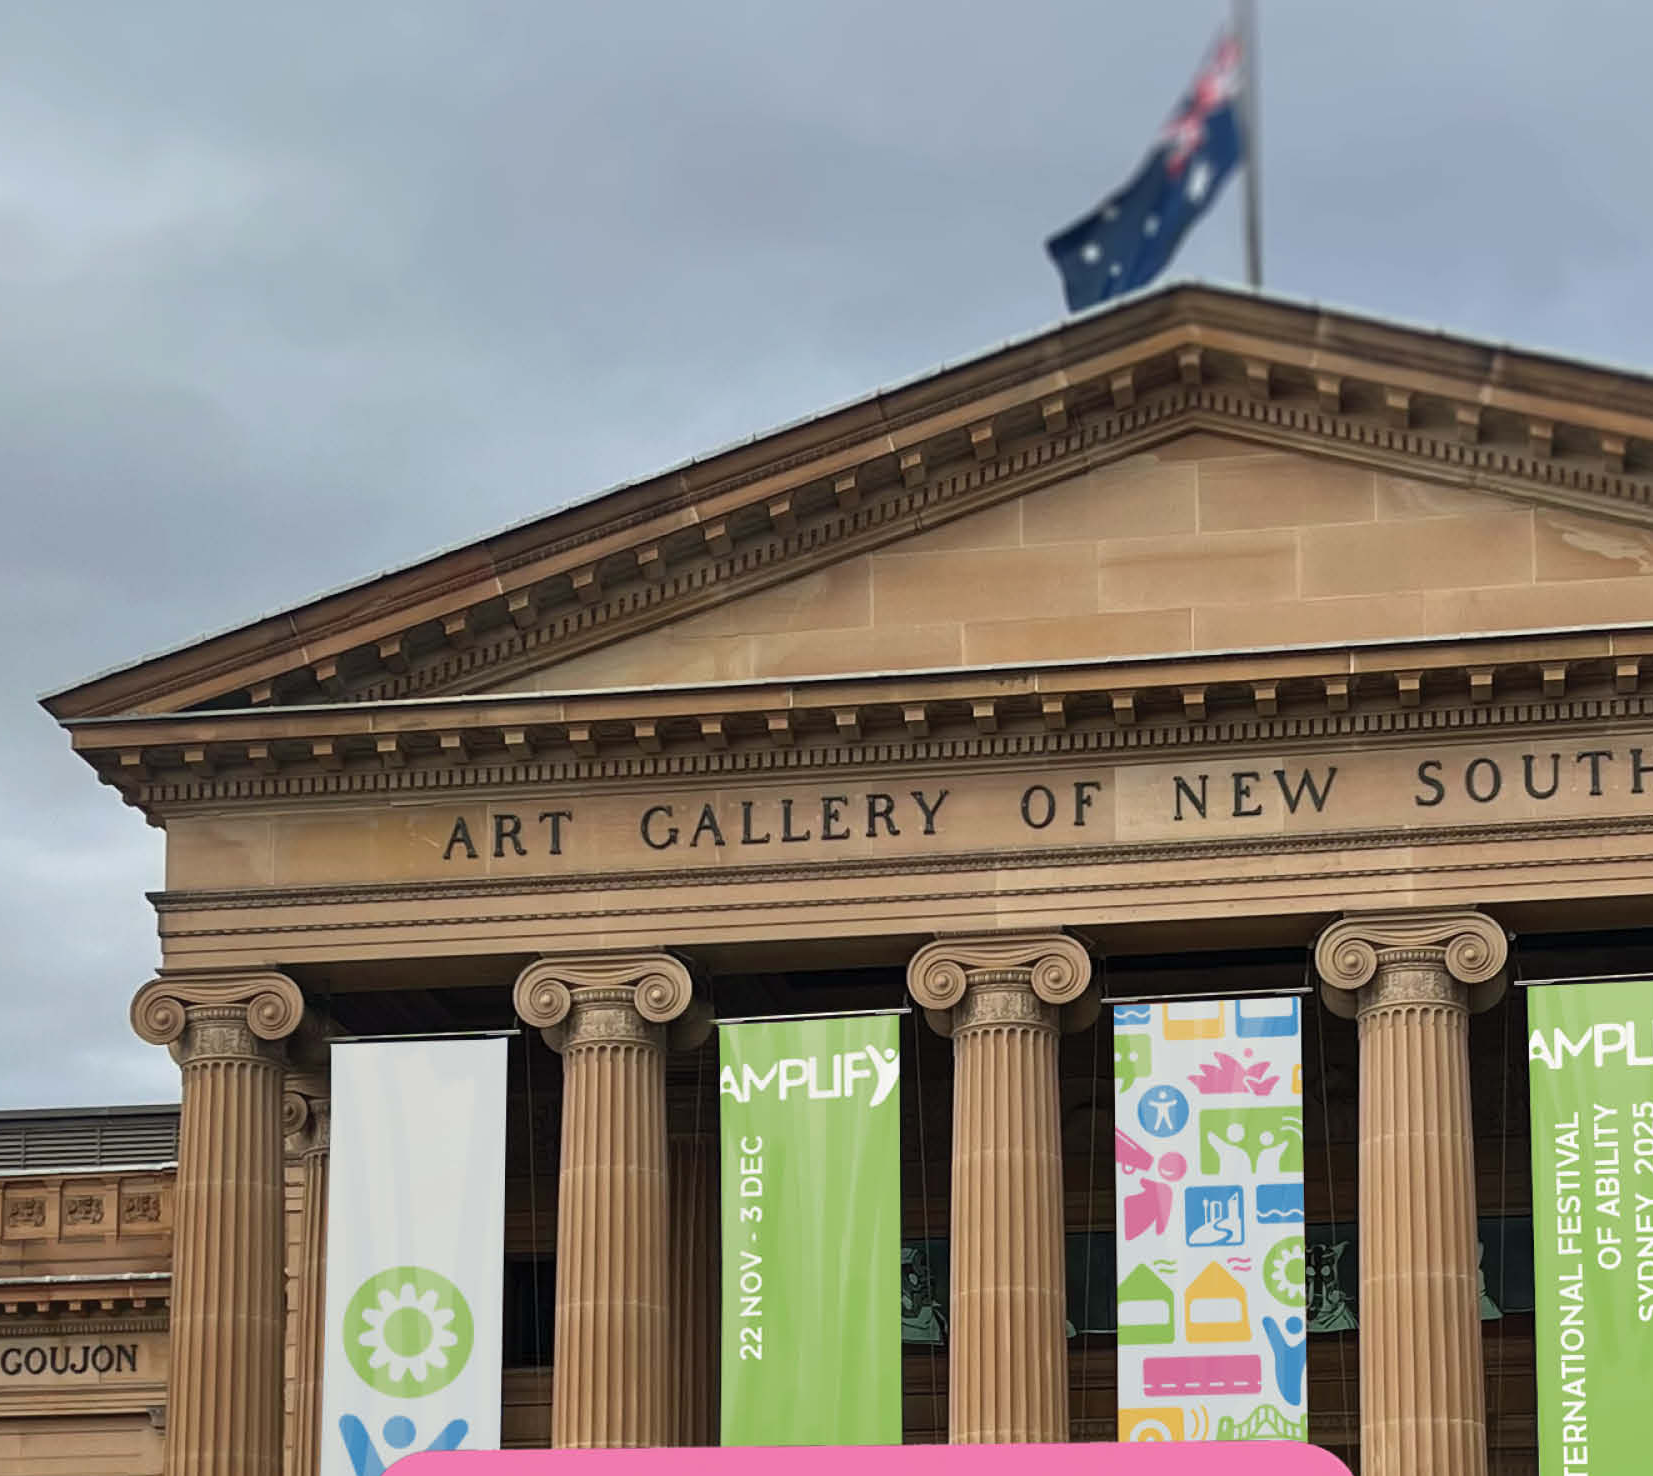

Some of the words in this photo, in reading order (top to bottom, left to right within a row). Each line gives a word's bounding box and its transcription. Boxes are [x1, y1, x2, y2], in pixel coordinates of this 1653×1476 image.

[442, 809, 574, 861] ART
[641, 788, 951, 849] GALLERY
[1020, 780, 1103, 830] OF
[1173, 765, 1338, 821] NEW
[720, 1045, 900, 1107] AMPLIFY
[739, 1135, 763, 1199] DEC
[1554, 1111, 1583, 1255] FESTIVAL
[1594, 1103, 1622, 1217] ABILITY
[739, 1205, 763, 1223] 3
[1596, 1227, 1623, 1271] OF
[738, 1250, 763, 1316] NOV
[0, 1343, 139, 1376] GOUJON
[738, 1327, 763, 1361] 22
